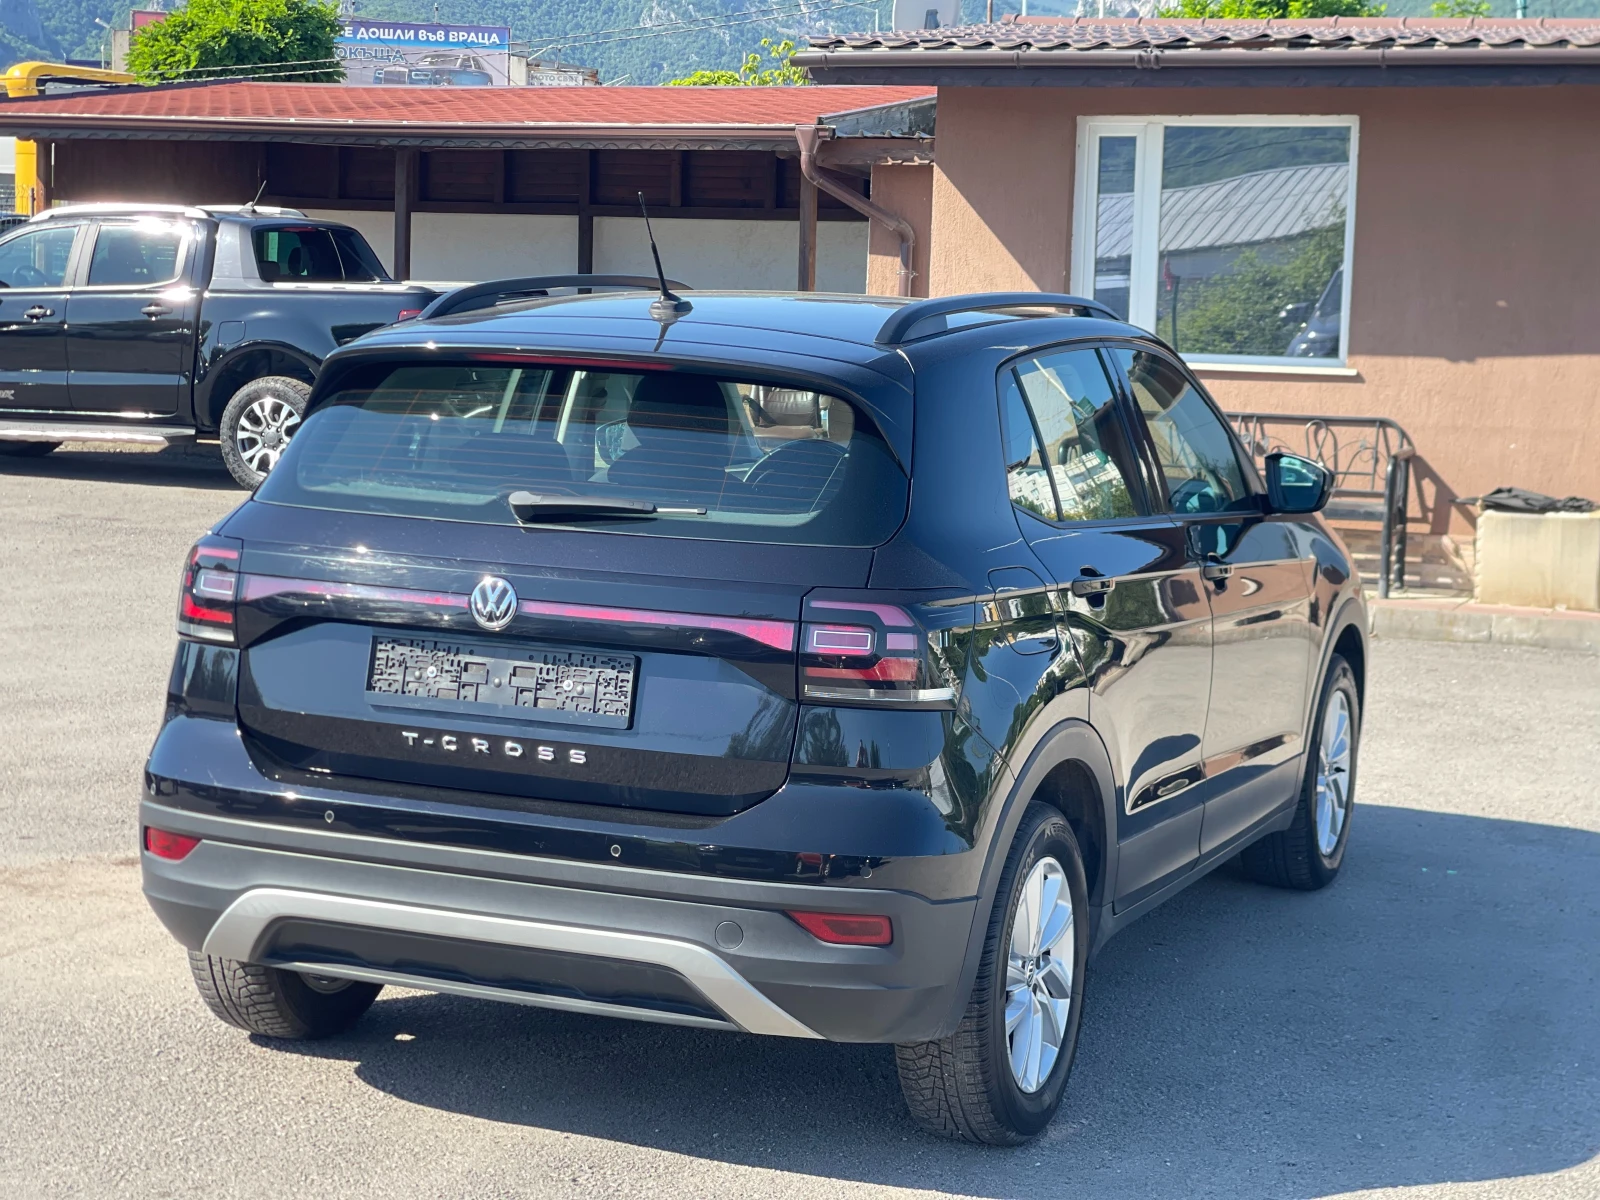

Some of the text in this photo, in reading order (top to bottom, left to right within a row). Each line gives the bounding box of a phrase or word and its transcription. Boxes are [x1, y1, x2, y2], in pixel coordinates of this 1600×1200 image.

[357, 27, 414, 40] ДОШЛИ
[449, 31, 500, 44] ВРАЦА
[335, 46, 406, 62] ОКЪЩА
[402, 731, 587, 764] T-CROSS
